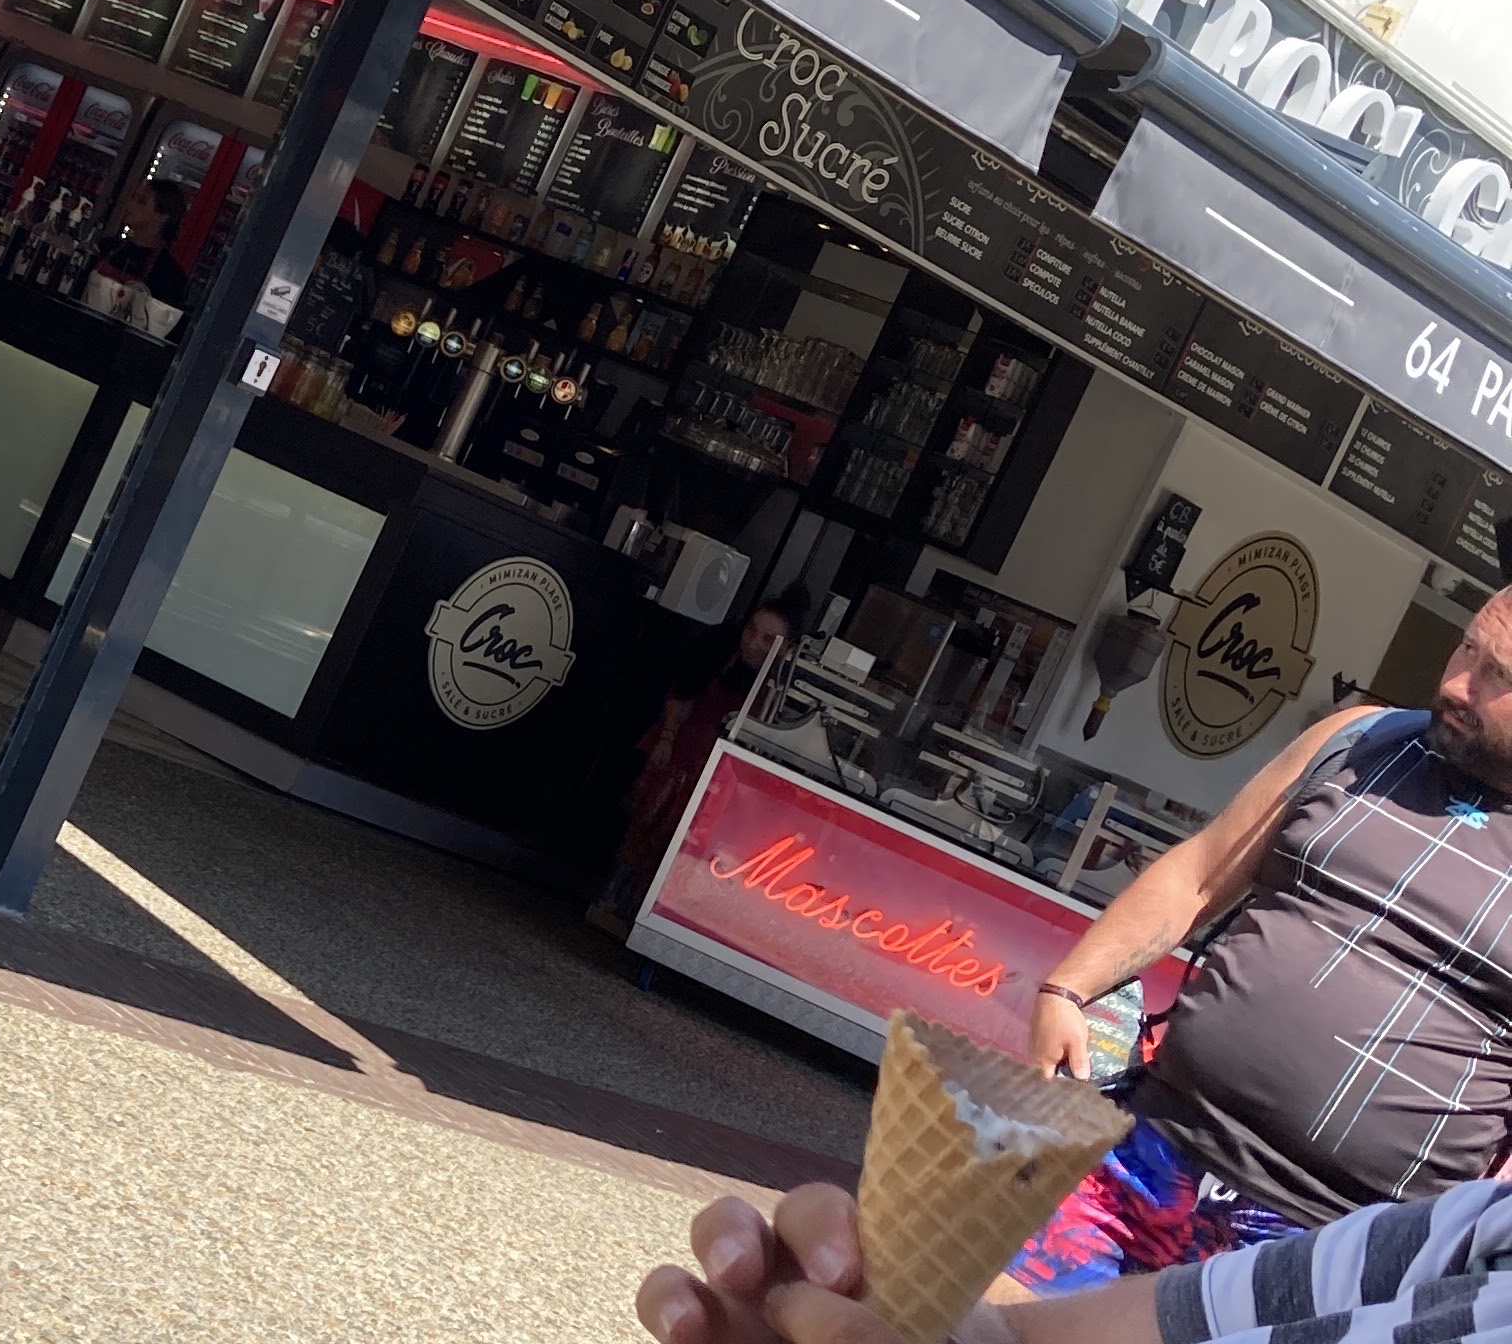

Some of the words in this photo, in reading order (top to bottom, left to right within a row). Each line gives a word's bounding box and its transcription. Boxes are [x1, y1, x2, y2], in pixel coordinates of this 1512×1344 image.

[736, 8, 847, 102] Croc
[758, 92, 899, 205] Sucré
[949, 196, 973, 216] SUCRE
[934, 226, 961, 248] BEURRE
[942, 211, 965, 231] SUCRE
[964, 224, 990, 246] CITRON
[1029, 263, 1062, 289] COMPOTE
[1036, 248, 1073, 276] CONFITURE
[1022, 277, 1060, 306] SPECULOOS
[1099, 286, 1127, 309] NUTELLA
[1084, 315, 1113, 338] NUTELLA
[1112, 330, 1132, 348] COCO
[1092, 300, 1119, 324] NUTELLA
[1119, 316, 1146, 338] BANANE
[1122, 354, 1156, 380] CHANTILLY
[1184, 356, 1213, 378] CARAMEL
[1211, 370, 1235, 392] MAISON
[1190, 341, 1223, 366] CHOCOLAT
[1222, 359, 1246, 380] MAISON
[1405, 321, 1461, 395] 64
[1169, 501, 1192, 523] CB
[489, 569, 538, 585] MIMIZAN
[539, 578, 563, 612] PLAGE
[1238, 546, 1290, 568] MIMIZAN
[1290, 558, 1311, 602] PLAGE
[460, 604, 543, 671] Croc
[1198, 593, 1281, 680] Croc
[710, 832, 1005, 997] Mascottes
